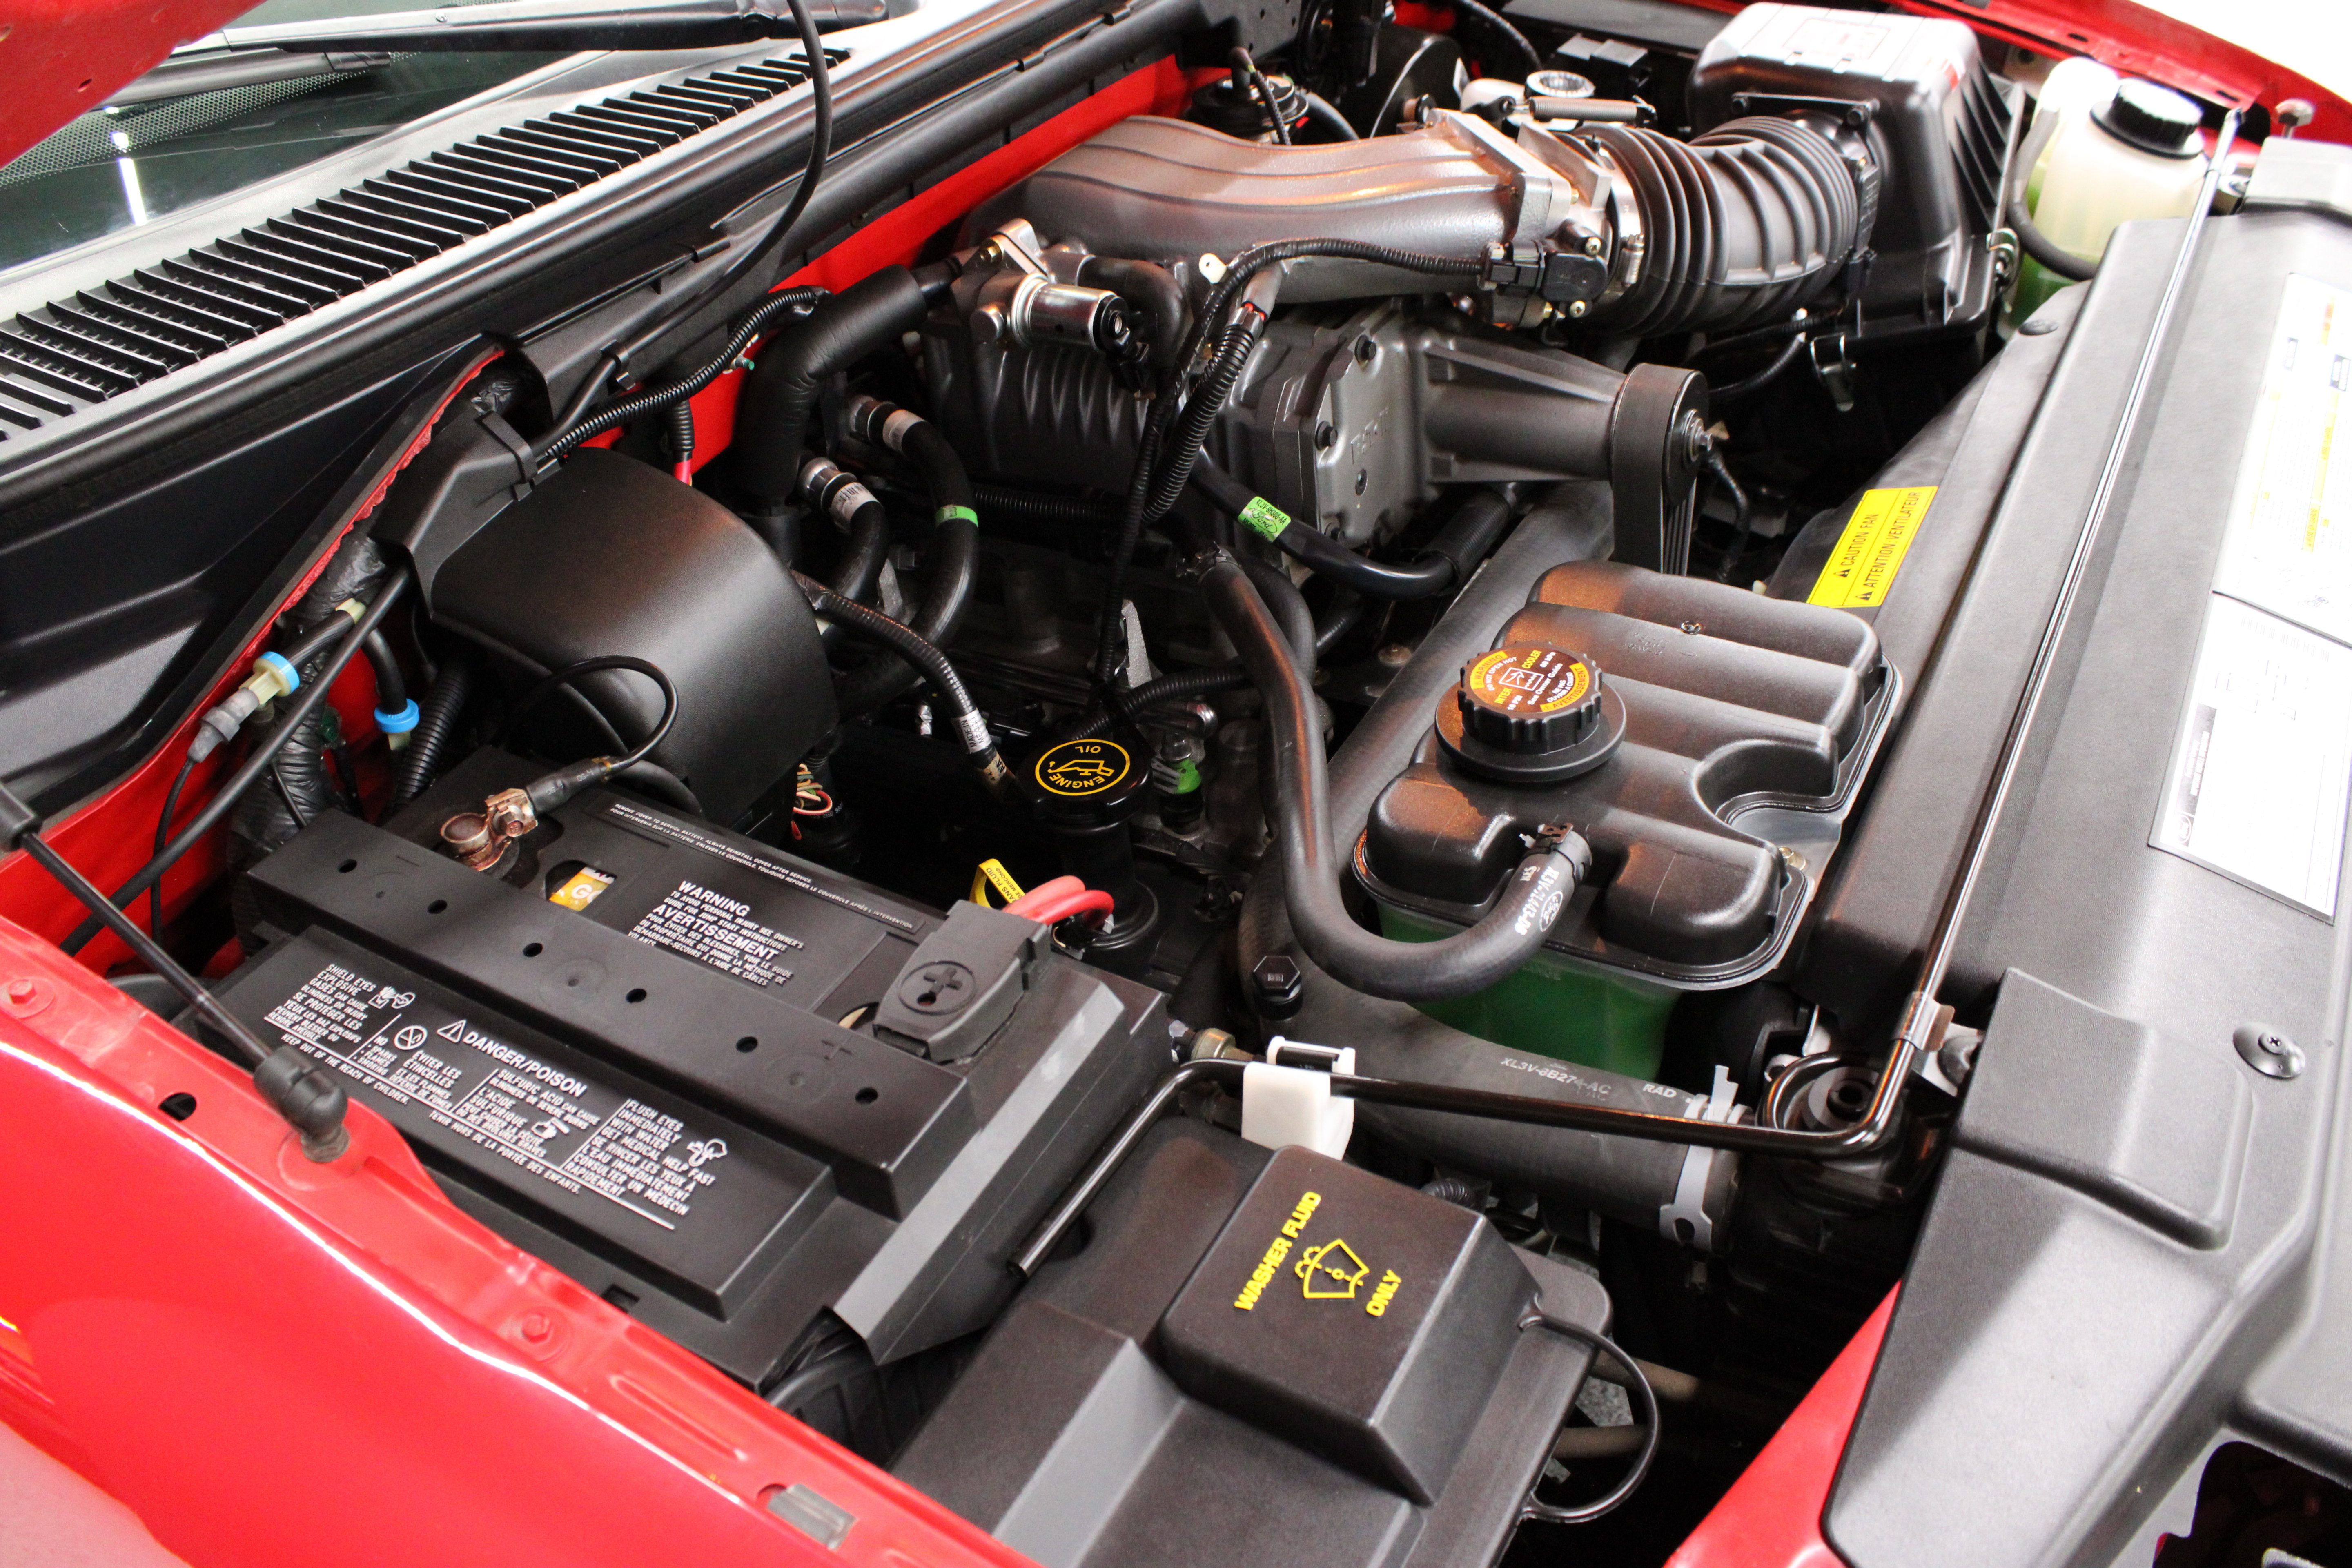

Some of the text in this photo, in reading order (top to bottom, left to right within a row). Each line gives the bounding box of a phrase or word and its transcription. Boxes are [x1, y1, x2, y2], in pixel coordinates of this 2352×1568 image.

[1252, 510, 1273, 529] Ford
[1860, 514, 1879, 528] FAN
[1474, 655, 1503, 679] WARNING
[1488, 662, 1503, 674] OPEN
[1522, 650, 1542, 668] COOLER
[1494, 688, 1513, 704] INTER
[1512, 695, 1523, 704] PSI
[1527, 663, 1563, 705] See Owner Guide
[1547, 689, 1569, 702] OUVRIR
[1553, 668, 1586, 708] AVERTISSEMENT
[1557, 680, 1566, 688] PAS
[961, 719, 977, 747] MADE IN
[1075, 745, 1101, 753] OIL
[1049, 773, 1105, 788] ENGINE
[679, 881, 750, 916] WARNING
[986, 868, 1015, 900] ANS FLUID
[653, 904, 779, 960] AVERTISSEMENT
[664, 898, 787, 950] GUIDE FOR JUMP START INSTRUCTIONS
[680, 895, 700, 906] AVOID
[701, 904, 733, 920] PERSONAL
[735, 918, 759, 930] INJURY
[759, 927, 773, 936] SEE
[774, 933, 804, 948] OWNER'S
[640, 920, 651, 928] DU
[697, 944, 710, 952] QUI
[707, 949, 733, 962] DONNE
[744, 963, 774, 979] MÉTHODE
[646, 913, 664, 924] POUR
[664, 920, 687, 934] ÉVITER
[688, 931, 702, 940] DES
[702, 937, 739, 958] BLESSURES,
[744, 954, 760, 965] VOIR
[772, 966, 793, 978] GUIDE
[326, 964, 376, 991] SHIELD EYES
[708, 958, 731, 970] L'AIDE
[310, 978, 368, 1011] GASES CAN CAUSE
[317, 971, 361, 996] EXPLOSIVE
[284, 1000, 306, 1014] YEUX
[303, 1011, 317, 1020] LES
[316, 1017, 330, 1027] GAZ
[293, 992, 307, 1002] SE
[344, 1018, 362, 1030] LES
[301, 985, 334, 1004] BLINDNESS
[344, 1007, 368, 1020] INJURY
[370, 1046, 397, 1062] SPARKS
[374, 1036, 388, 1046] NO
[281, 1033, 301, 1045] KEEP
[300, 1043, 315, 1053] OUT
[325, 1056, 340, 1067] THE
[339, 1064, 363, 1079] REACH
[374, 1082, 409, 1104] CHILDREN.
[358, 1057, 388, 1075] SMOKING
[364, 1051, 390, 1067] FLAMES
[403, 1058, 454, 1088] ÉTINCELLES
[412, 1050, 461, 1079] ÉVITER LES
[463, 1031, 587, 1096] DANGER/POISON
[394, 1068, 451, 1099] ET LES FLAMMES
[478, 1087, 515, 1109] L'ACIDE
[498, 1069, 600, 1125] SULFURIC ACID CAN CAUSE
[1642, 1083, 1677, 1098] RAD
[467, 1094, 528, 1127] SULFURIQUE
[618, 1109, 681, 1143] IMMEDIATELY
[626, 1100, 683, 1131] FLUSH EYES
[610, 1118, 669, 1151] WITH WATER
[429, 1110, 452, 1125] TENIR
[451, 1122, 473, 1136] HORS
[472, 1133, 486, 1143] DE
[485, 1140, 497, 1149] LA
[527, 1161, 544, 1174] DES
[544, 1170, 580, 1194] ENFANTS.
[582, 1144, 612, 1163] L'EAU
[592, 1136, 607, 1148] SE
[606, 1143, 640, 1164] RINCER
[637, 1160, 660, 1174] LES
[661, 1169, 686, 1187] YEUX
[601, 1126, 715, 1185] GET MEDICAL HELP FAST
[565, 1162, 625, 1197] RAPIDEMENT
[574, 1152, 627, 1184] CONSULTER
[623, 1180, 644, 1193] UN
[1234, 1192, 1321, 1310] WASHER FLUID
[1365, 1269, 1401, 1316] ONLY
